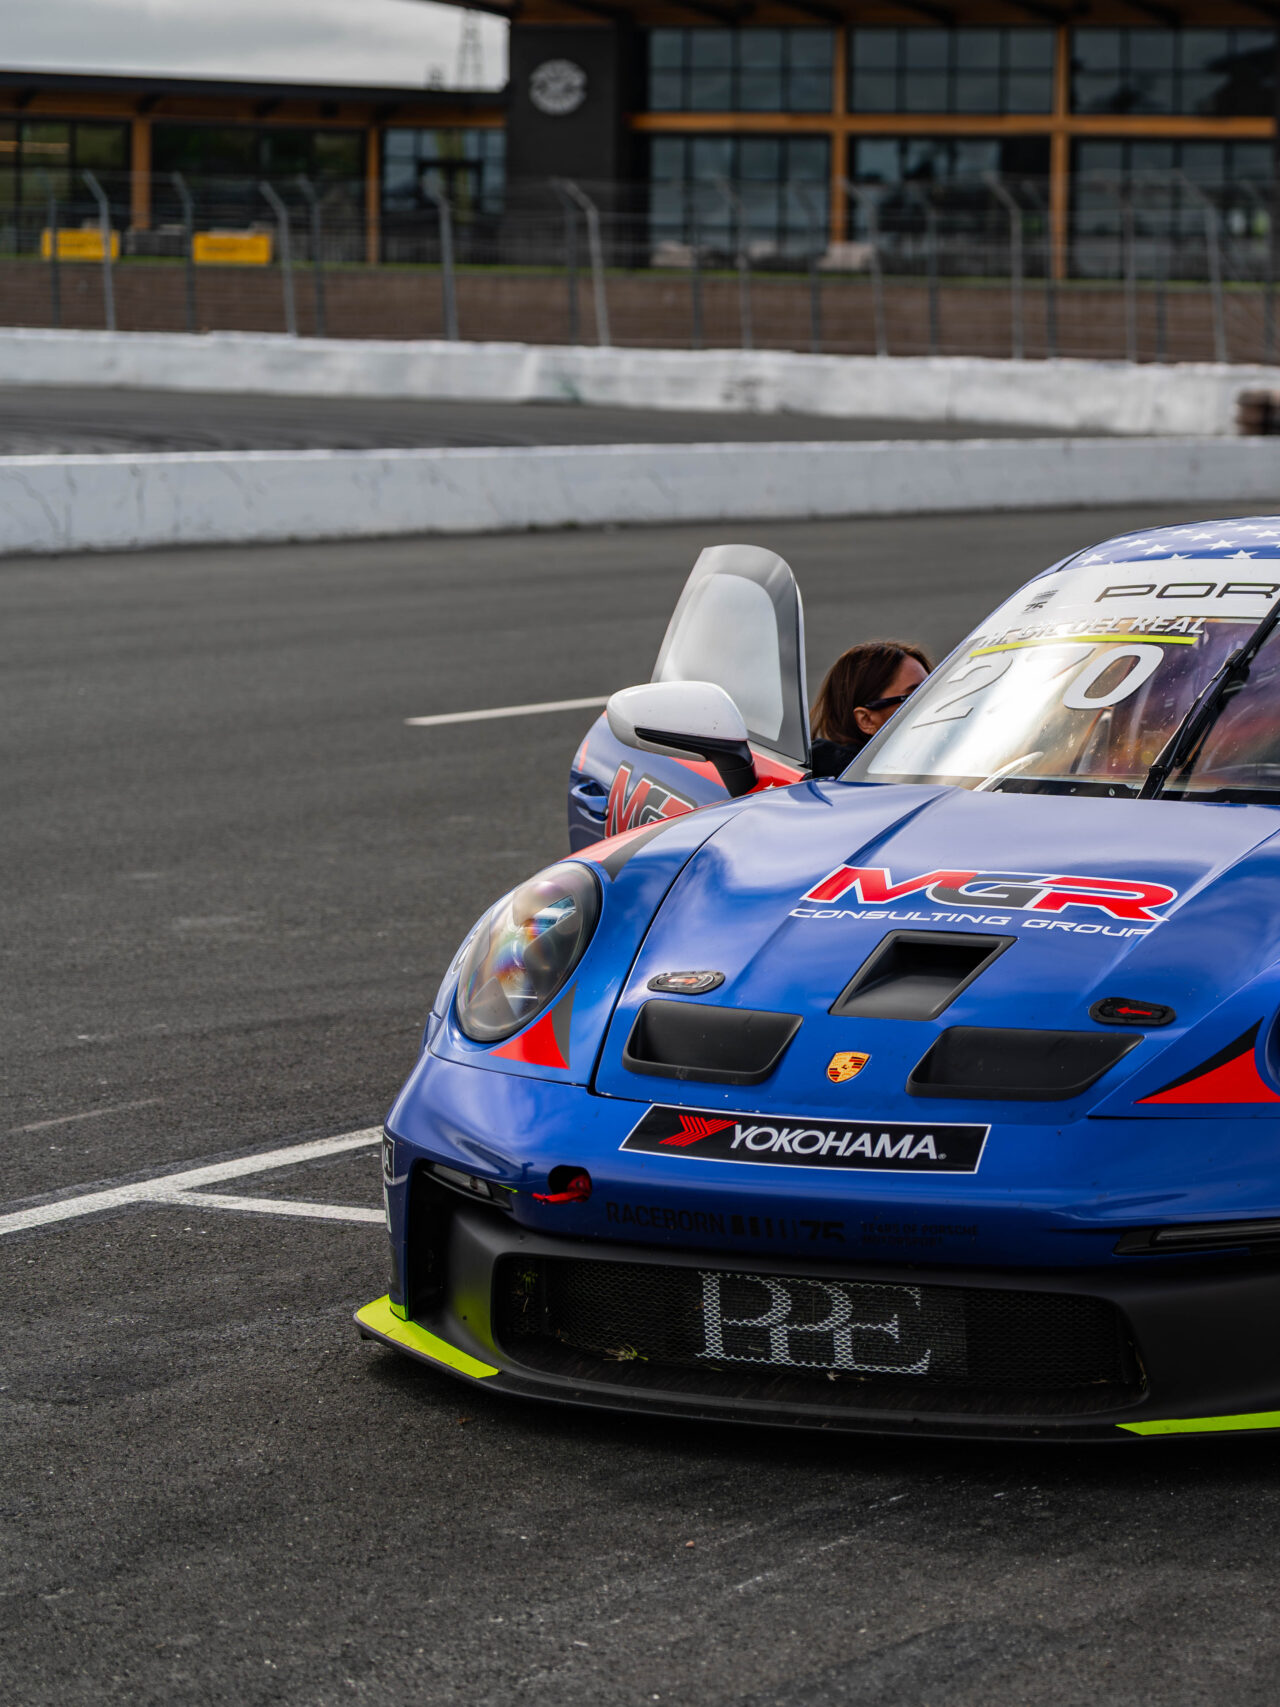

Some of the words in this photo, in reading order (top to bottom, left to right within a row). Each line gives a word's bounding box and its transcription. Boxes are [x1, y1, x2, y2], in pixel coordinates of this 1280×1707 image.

[1129, 616, 1206, 634] REAL
[799, 864, 1178, 922] MGR
[788, 907, 1012, 925] CONSULTING
[1022, 919, 1156, 938] GROUP
[730, 1123, 940, 1160] YOKOHAMA
[605, 1201, 726, 1235] RACEBORN
[800, 1219, 847, 1243] 75
